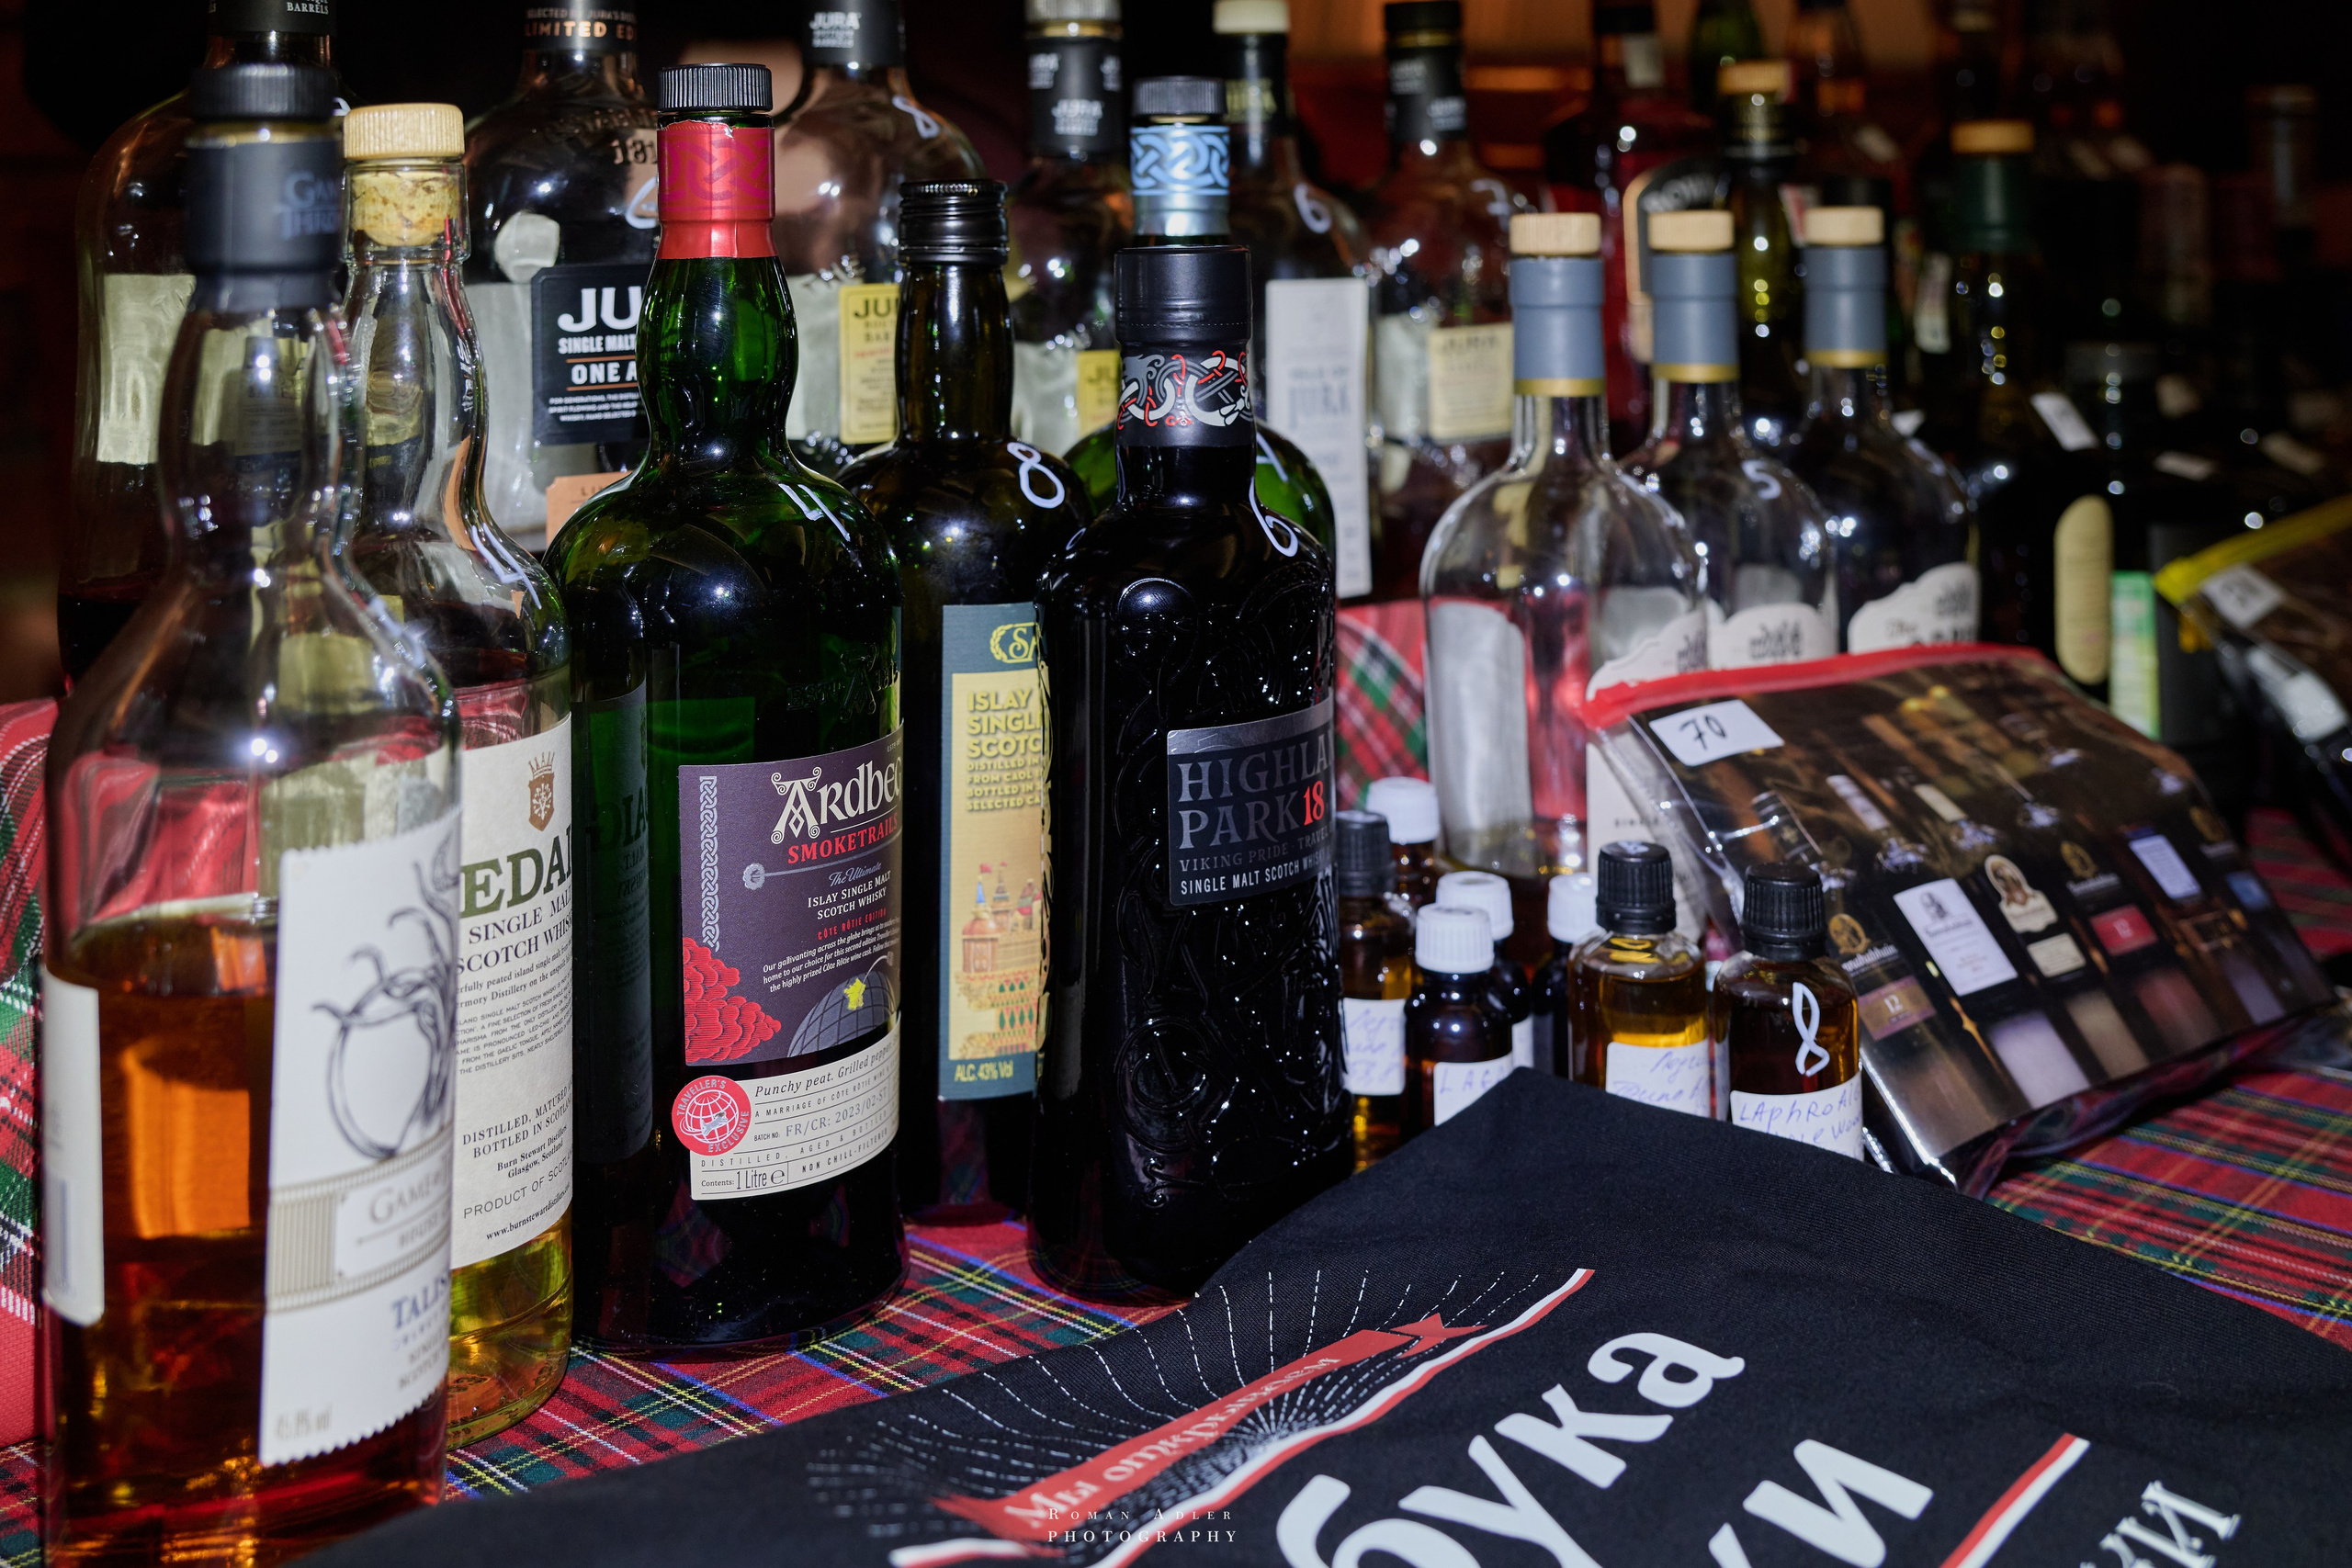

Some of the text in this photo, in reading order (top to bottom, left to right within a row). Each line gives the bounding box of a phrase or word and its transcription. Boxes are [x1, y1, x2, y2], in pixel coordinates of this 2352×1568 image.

[287, 2, 329, 15] BARRELS
[525, 20, 607, 38] LIMITED
[558, 336, 604, 355] SINGLE
[571, 363, 620, 385] ONE
[1007, 442, 1065, 508] 8
[967, 689, 1032, 712] ISLAY
[1679, 714, 1727, 750] 70
[967, 758, 1024, 773] DISTILLED
[967, 773, 1000, 785] FROM
[967, 784, 1018, 797] BOTTLED
[967, 796, 1023, 811] SELECTED
[1178, 780, 1325, 850] PARK 18
[787, 811, 898, 864] SMOKETRAILS
[1179, 852, 1243, 873] VIKING
[1249, 840, 1288, 863] PRIDE
[808, 870, 891, 908] ISLAY SINGLE MALT
[829, 862, 882, 887] The Ultimate
[1181, 859, 1300, 895] SINGLE MALT SCOTCH
[817, 886, 887, 919] SCOTCH WHISKY
[469, 906, 543, 945] SINGLE
[818, 925, 837, 941] CÔTE
[842, 916, 862, 932] RÔTIE
[456, 935, 538, 976] SCOTCH
[763, 964, 776, 974] Our
[778, 948, 816, 968] gallivanting
[818, 941, 836, 953] across
[837, 936, 846, 945] the
[763, 942, 862, 985] home to our choice for this second
[487, 971, 512, 989] peated
[514, 964, 534, 979] island
[536, 955, 551, 972] single
[491, 983, 526, 1001] Distillery
[529, 977, 537, 987] on
[539, 972, 548, 984] the
[770, 984, 781, 993] the
[782, 976, 802, 988] highly
[803, 968, 822, 982] prized
[481, 1010, 503, 1021] SINGLE
[505, 1002, 520, 1013] MALT
[522, 994, 542, 1008] SCOTCH
[487, 1021, 502, 1030] FINE
[503, 1009, 531, 1024] SELECTION
[483, 1031, 526, 1050] PRONOUNCED
[491, 1028, 507, 1037] FROM
[1792, 982, 1830, 1077] 8
[462, 1055, 481, 1065] FROM
[483, 1051, 495, 1059] THE
[497, 1043, 517, 1055] GAELIC
[475, 1055, 510, 1072] DISTILLERY
[754, 1058, 869, 1099] Punchy peat. Grilled
[676, 1078, 727, 1116] TRAVELLER'S
[755, 1110, 760, 1118] A
[765, 1100, 812, 1116] MARRIAGE
[818, 1097, 827, 1105] OF
[831, 1088, 849, 1101] CÔTE
[463, 1086, 568, 1145] DISTILLED, MATURED
[753, 1133, 770, 1142] BATCH
[771, 1131, 781, 1140] NO:
[786, 1116, 831, 1137] FR/CR:
[473, 1121, 542, 1159] BOTTLED IN
[707, 1111, 750, 1153] EXCLUSIVE
[497, 1124, 567, 1172] Burn Stewart Distillers
[508, 1139, 563, 1179] Glasgow, Scotland
[800, 1140, 830, 1154] AGED
[701, 1179, 734, 1188] Contents:
[745, 1169, 767, 1189] Litre
[802, 1162, 820, 1173] NON
[464, 1176, 545, 1219] PRODUCT OF
